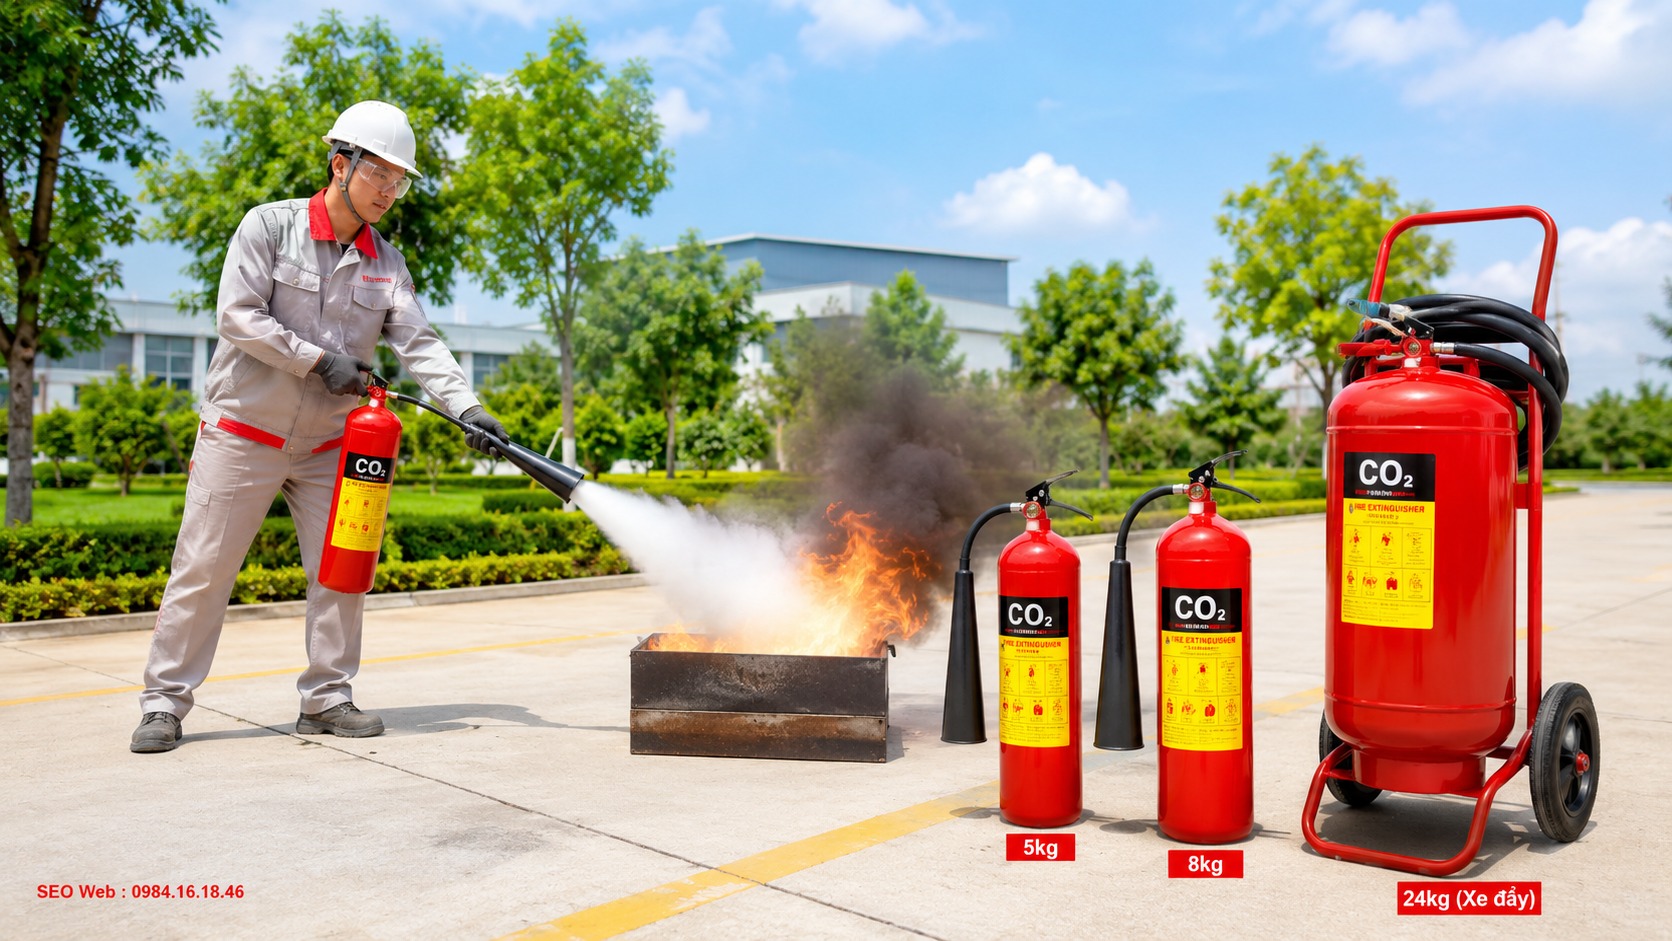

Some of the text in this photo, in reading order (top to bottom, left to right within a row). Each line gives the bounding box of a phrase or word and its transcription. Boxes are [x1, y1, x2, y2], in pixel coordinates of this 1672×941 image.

[1359, 459, 1413, 488] CO2
[1368, 503, 1425, 513] EXTINGUISHER
[1008, 602, 1053, 627] CO2
[1175, 595, 1226, 621] CO2
